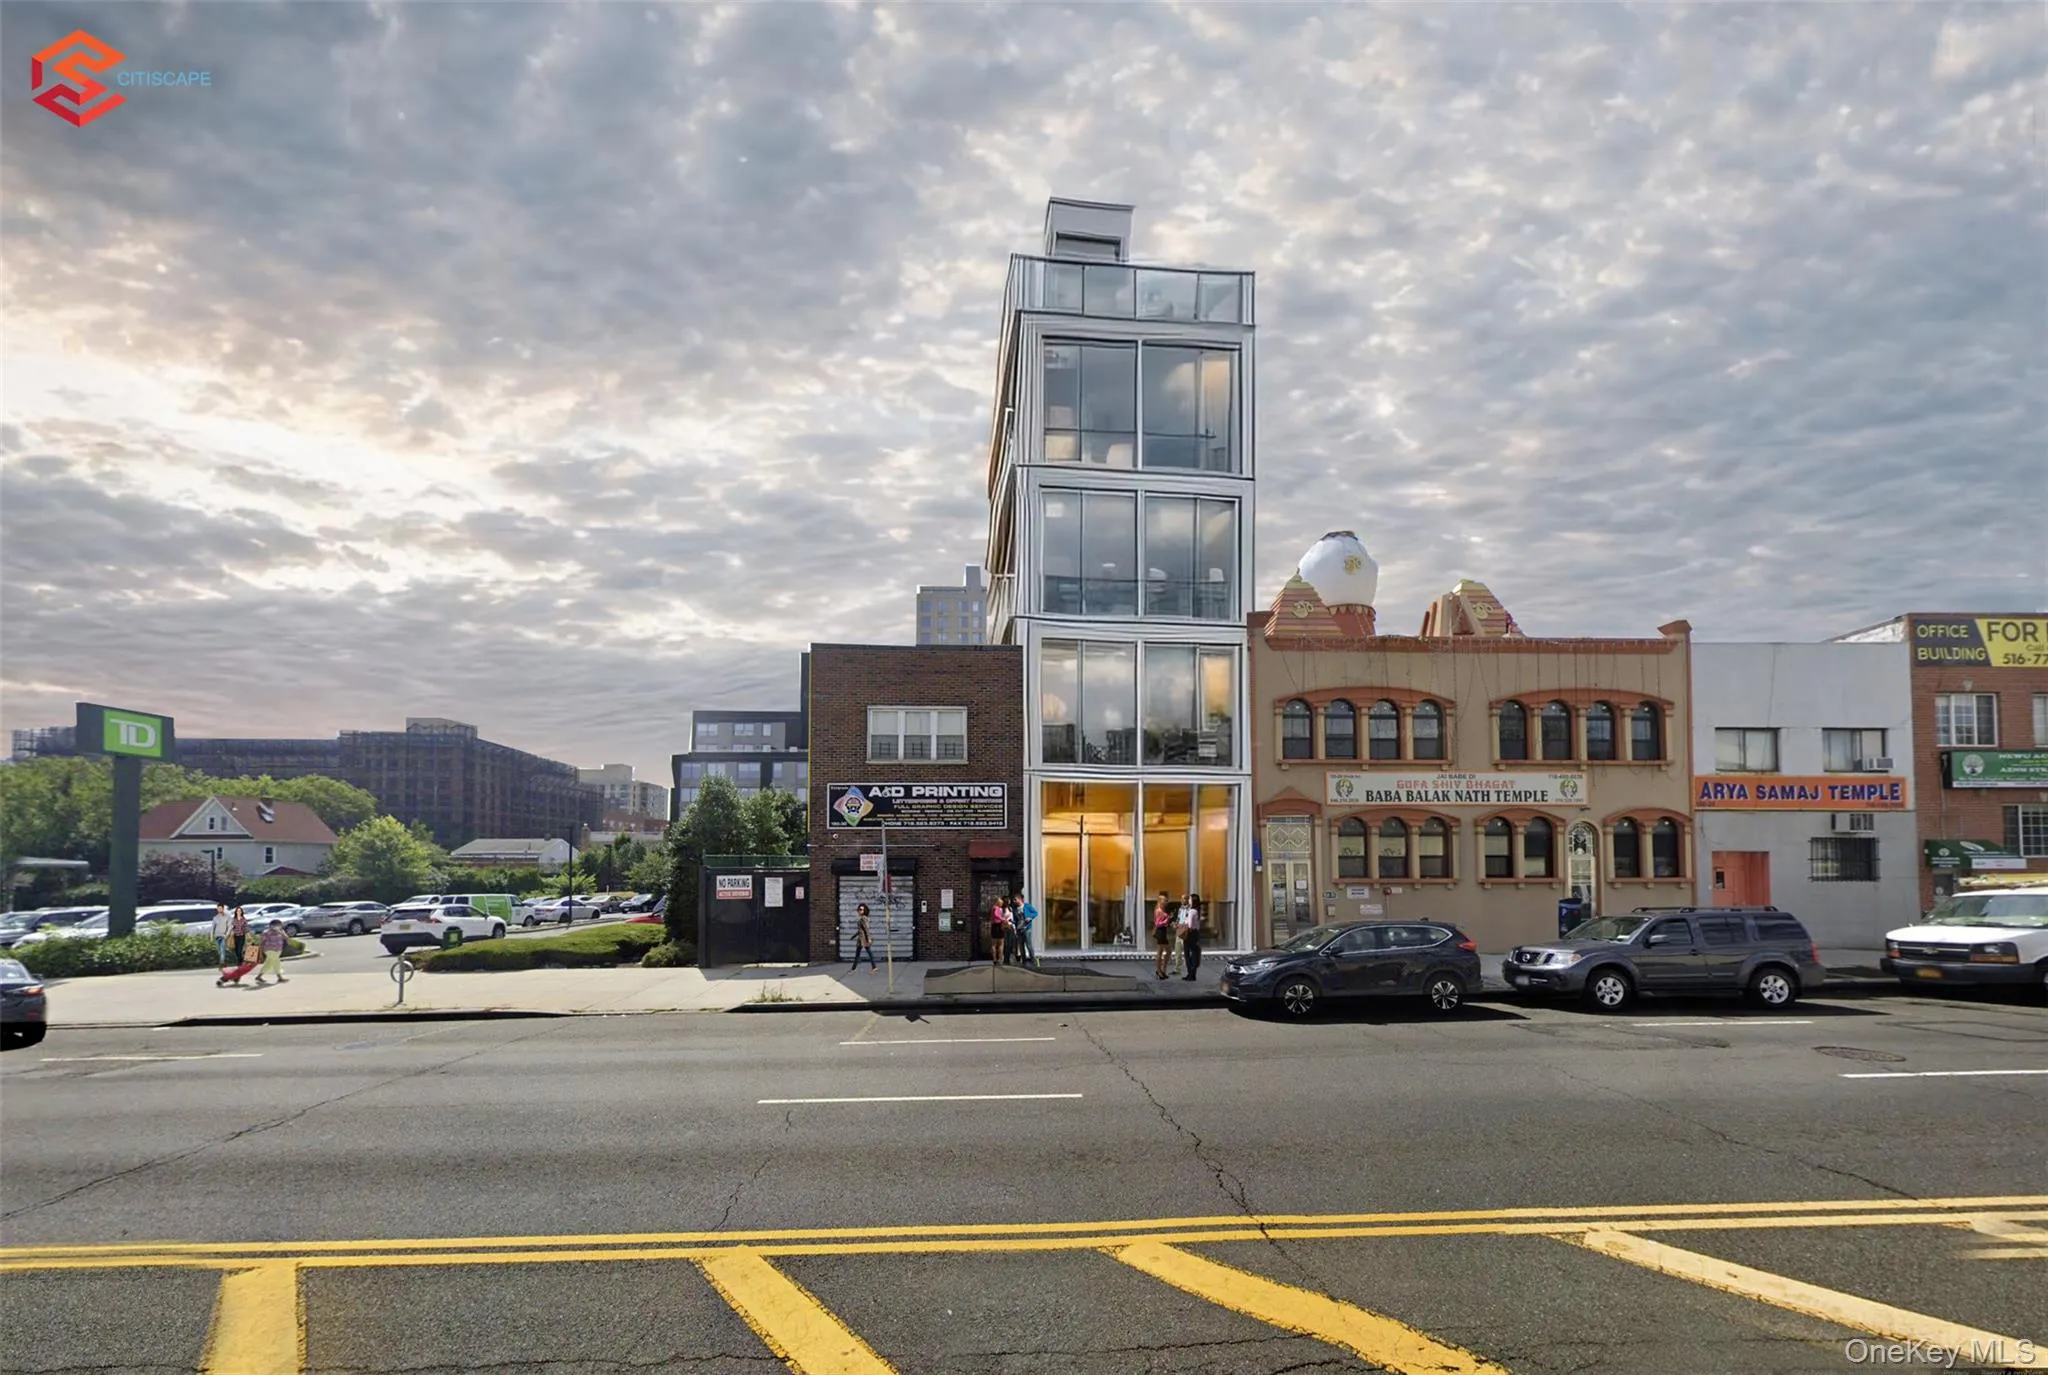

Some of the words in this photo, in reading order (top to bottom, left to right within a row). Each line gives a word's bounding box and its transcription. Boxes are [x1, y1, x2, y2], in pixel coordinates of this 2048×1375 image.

[1917, 625, 1969, 638] OFFICE
[1987, 621, 2039, 642] FOR
[1917, 647, 1987, 660] BUILDING
[110, 719, 157, 748] TD
[1432, 780, 1461, 789] SHIV
[1700, 781, 1749, 800] ARYA
[1756, 784, 1820, 800] SAMAJ
[1828, 783, 1901, 801] TEMPLE
[868, 785, 905, 798] A&D
[912, 786, 1003, 798] PRINTING
[1365, 790, 1402, 802] BABA
[1406, 790, 1450, 802] BALAK
[1455, 790, 1491, 802] NATH
[1495, 790, 1548, 802] TEMPLE
[718, 877, 726, 888] NO
[727, 877, 750, 888] PARKING
